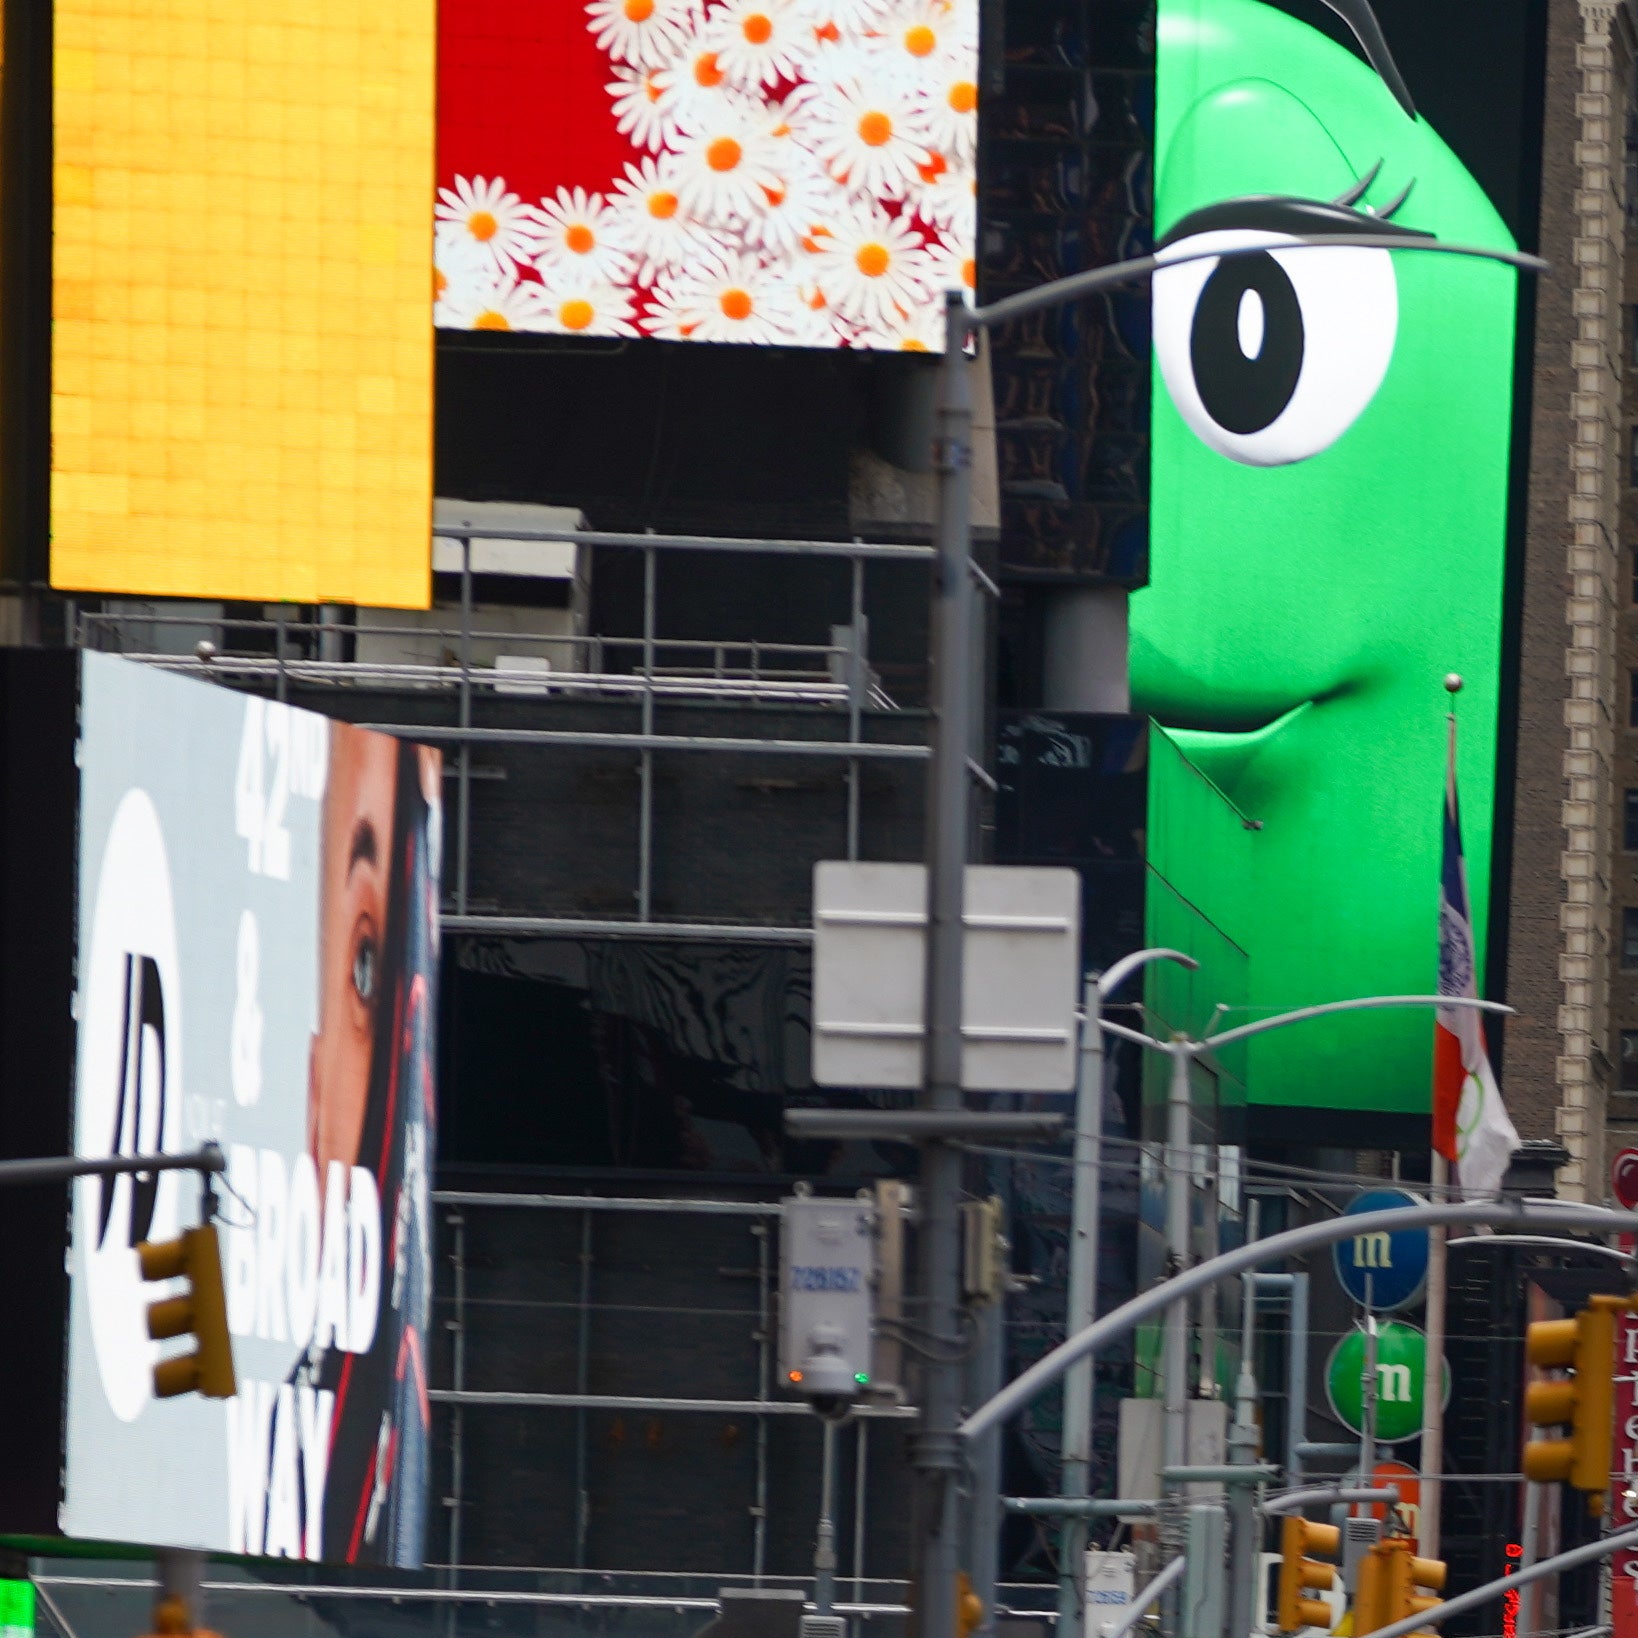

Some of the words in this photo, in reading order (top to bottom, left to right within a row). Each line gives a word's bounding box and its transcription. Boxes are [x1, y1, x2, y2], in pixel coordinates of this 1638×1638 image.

[226, 1142, 383, 1354] BROAD
[225, 1376, 335, 1563] WAY
[1374, 1361, 1412, 1404] m
